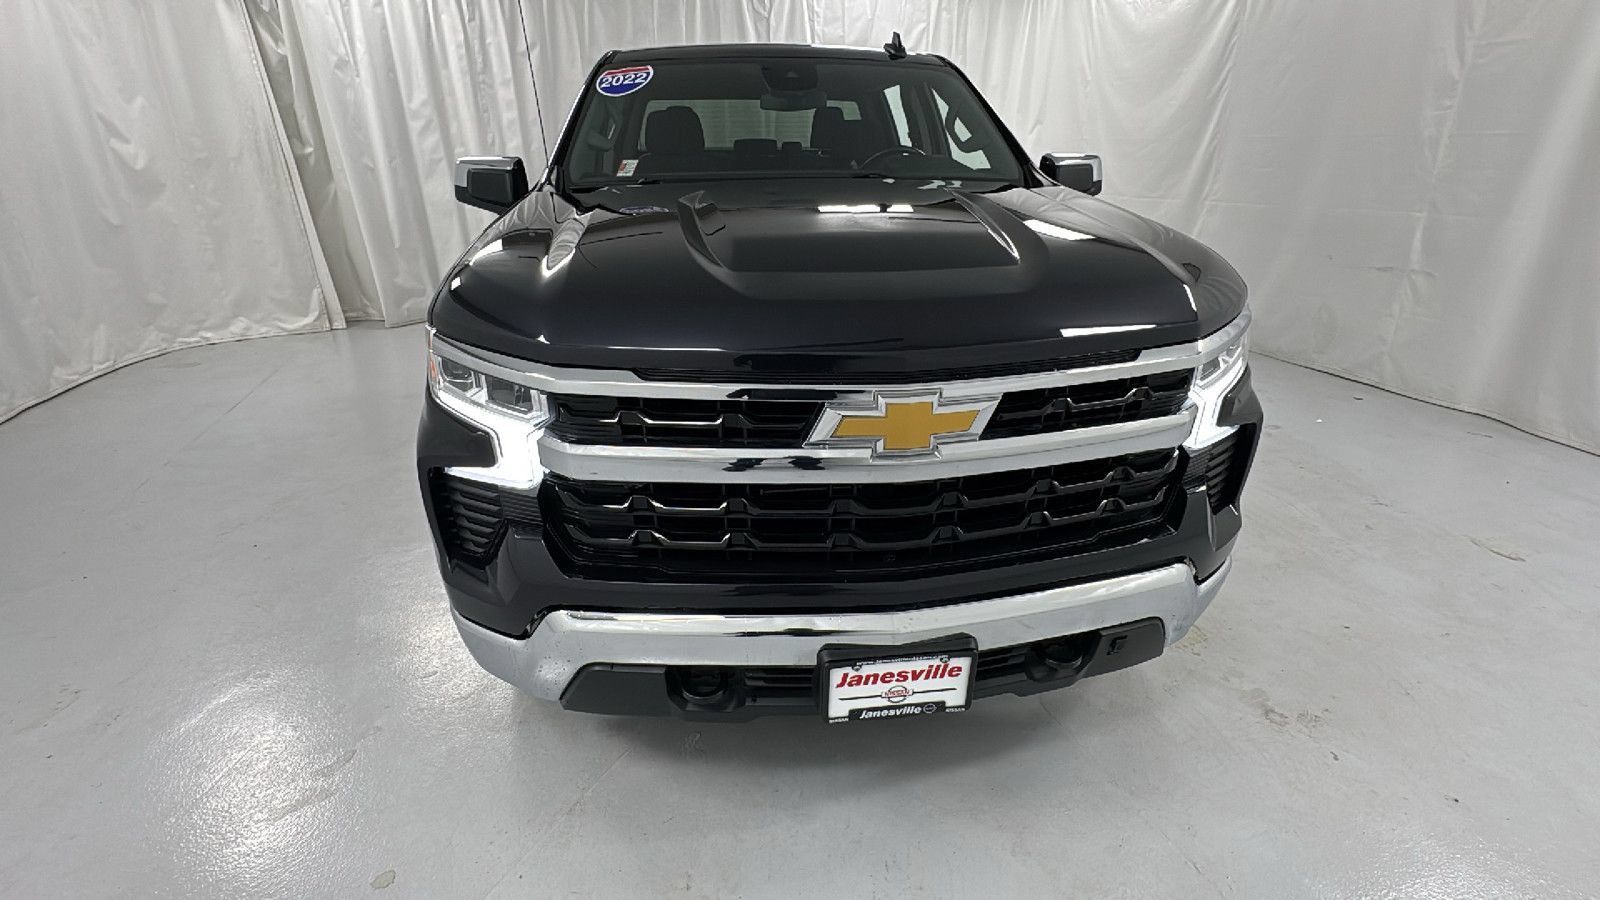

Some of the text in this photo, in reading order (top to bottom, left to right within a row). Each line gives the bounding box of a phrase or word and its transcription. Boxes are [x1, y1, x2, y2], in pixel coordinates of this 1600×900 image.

[600, 73, 647, 88] 2022
[836, 663, 962, 688] Janesville
[859, 705, 922, 719] Janesville
